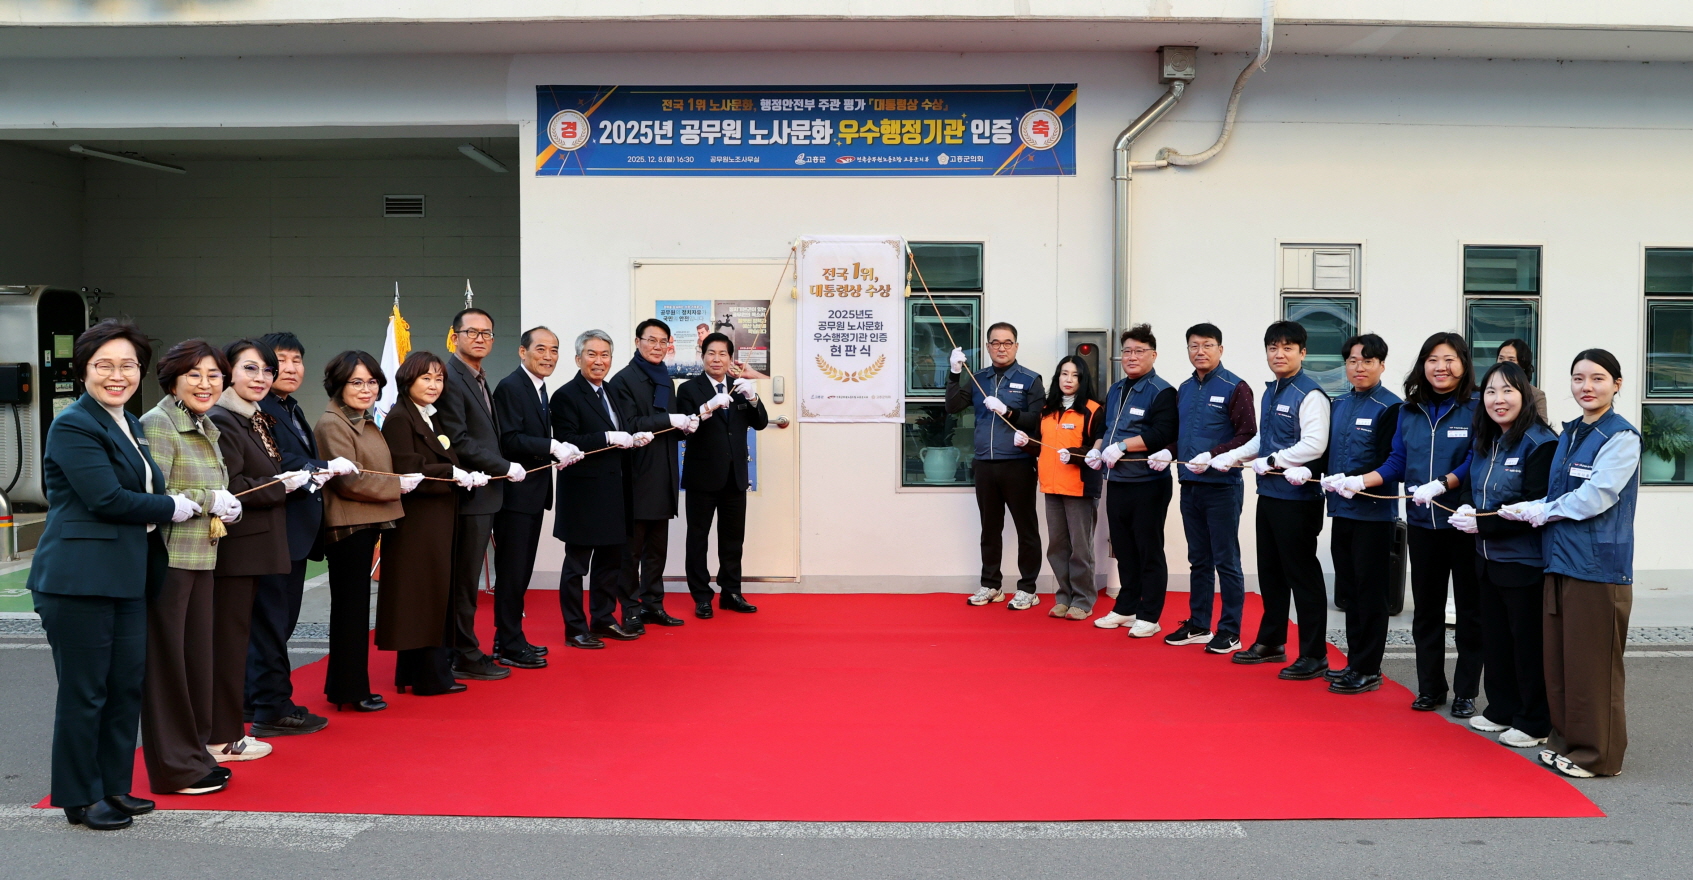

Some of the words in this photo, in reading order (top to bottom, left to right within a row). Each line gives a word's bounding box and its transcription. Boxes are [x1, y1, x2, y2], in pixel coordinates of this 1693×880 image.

[662, 98, 684, 111] 전국
[688, 98, 706, 111] 1위
[709, 99, 757, 112] 노사문화,
[760, 98, 815, 111] 행정안전부
[818, 98, 841, 111] 주관
[843, 98, 866, 111] 평가
[561, 121, 577, 138] 경
[599, 119, 673, 145] 2025년
[680, 119, 742, 145] 공무원
[748, 119, 833, 145] 노사문화
[838, 119, 965, 145] 우수행정기관
[971, 119, 1012, 144] 인증
[1032, 120, 1050, 138] 축
[627, 155, 646, 163] 2025.
[648, 155, 657, 163] 12.
[677, 155, 694, 163] 16:30
[710, 155, 760, 163] 공무원노조사무실
[806, 155, 826, 163] 고흥군
[950, 155, 984, 163] 고흥군의회
[822, 267, 849, 281] 전국
[852, 262, 878, 282] 1위,
[809, 284, 862, 298] 대통령상
[865, 284, 891, 298] 수상
[828, 309, 873, 319] 2025년도
[818, 321, 845, 331] 공무원
[847, 321, 884, 331] 노사문화
[813, 332, 868, 343] 우수행정기관
[870, 332, 888, 342] 인증
